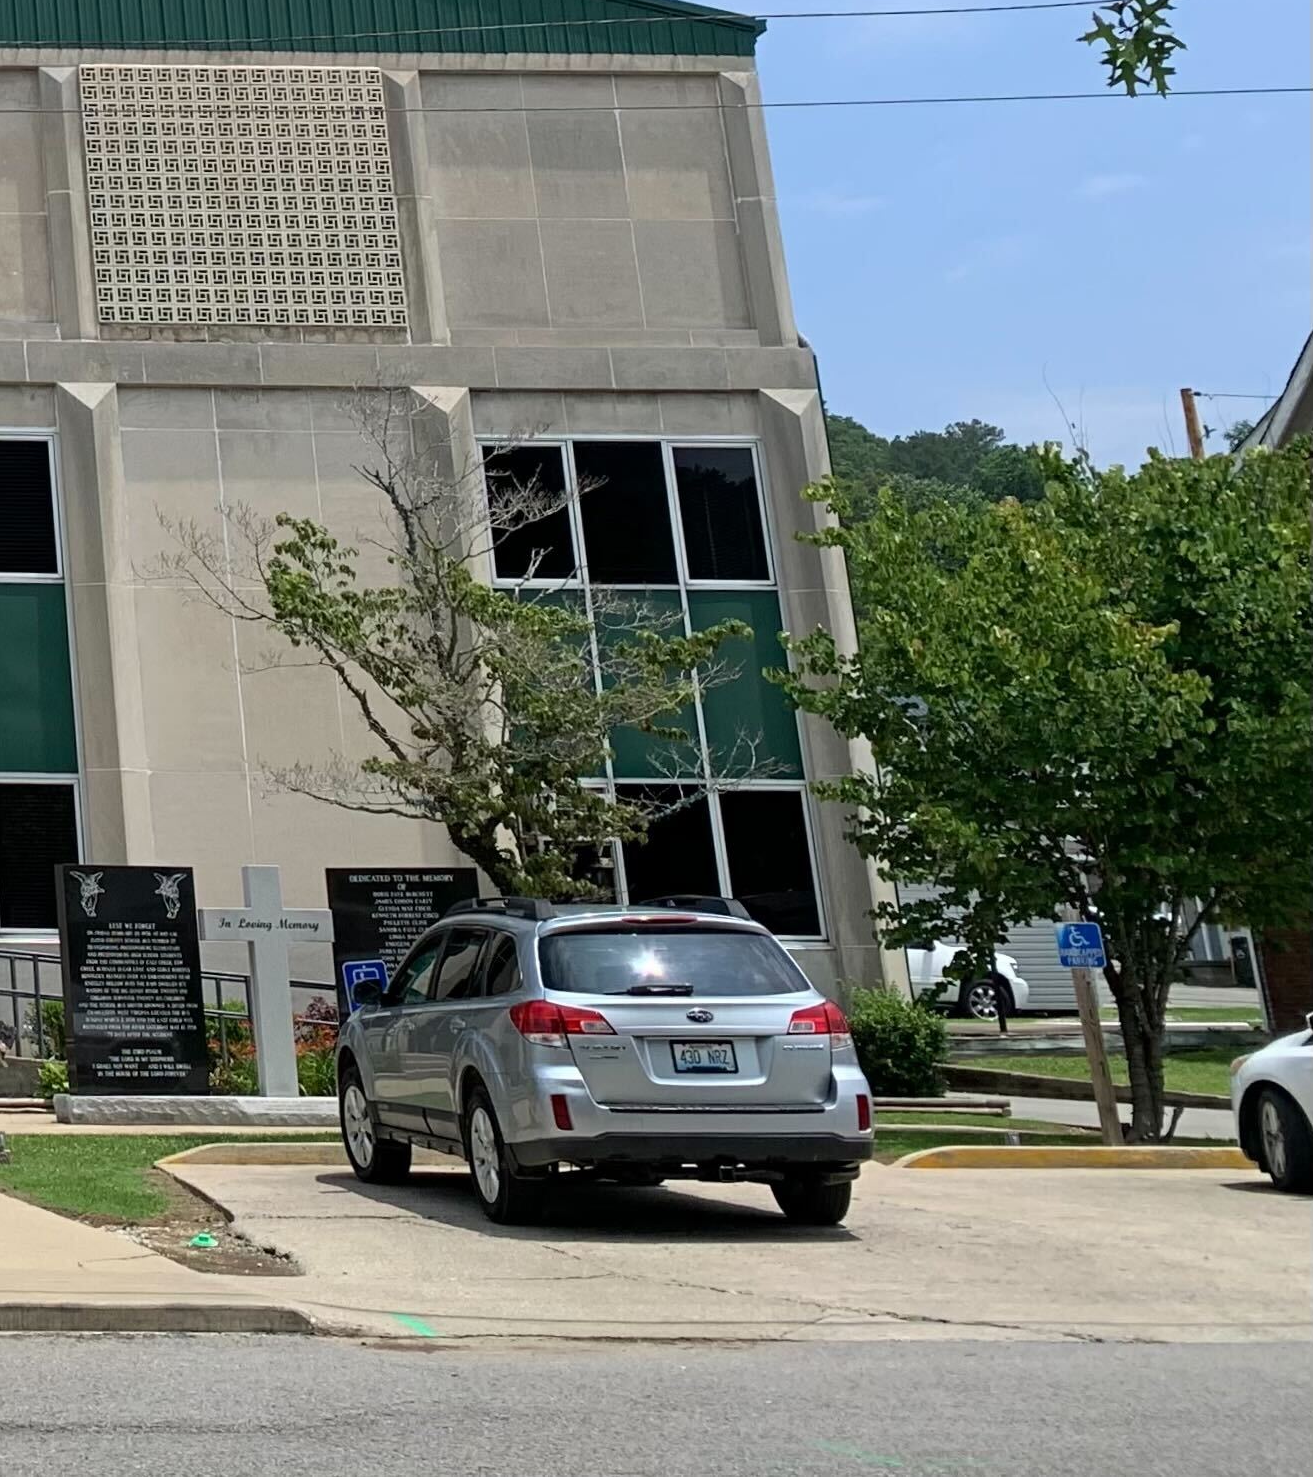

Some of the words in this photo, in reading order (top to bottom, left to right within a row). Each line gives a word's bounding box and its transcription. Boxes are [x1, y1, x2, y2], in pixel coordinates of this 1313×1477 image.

[349, 875, 390, 883] DEDICATED
[218, 918, 231, 928] In
[238, 918, 272, 931] Loving
[276, 918, 319, 932] Memory
[707, 1050, 730, 1065] NRZ
